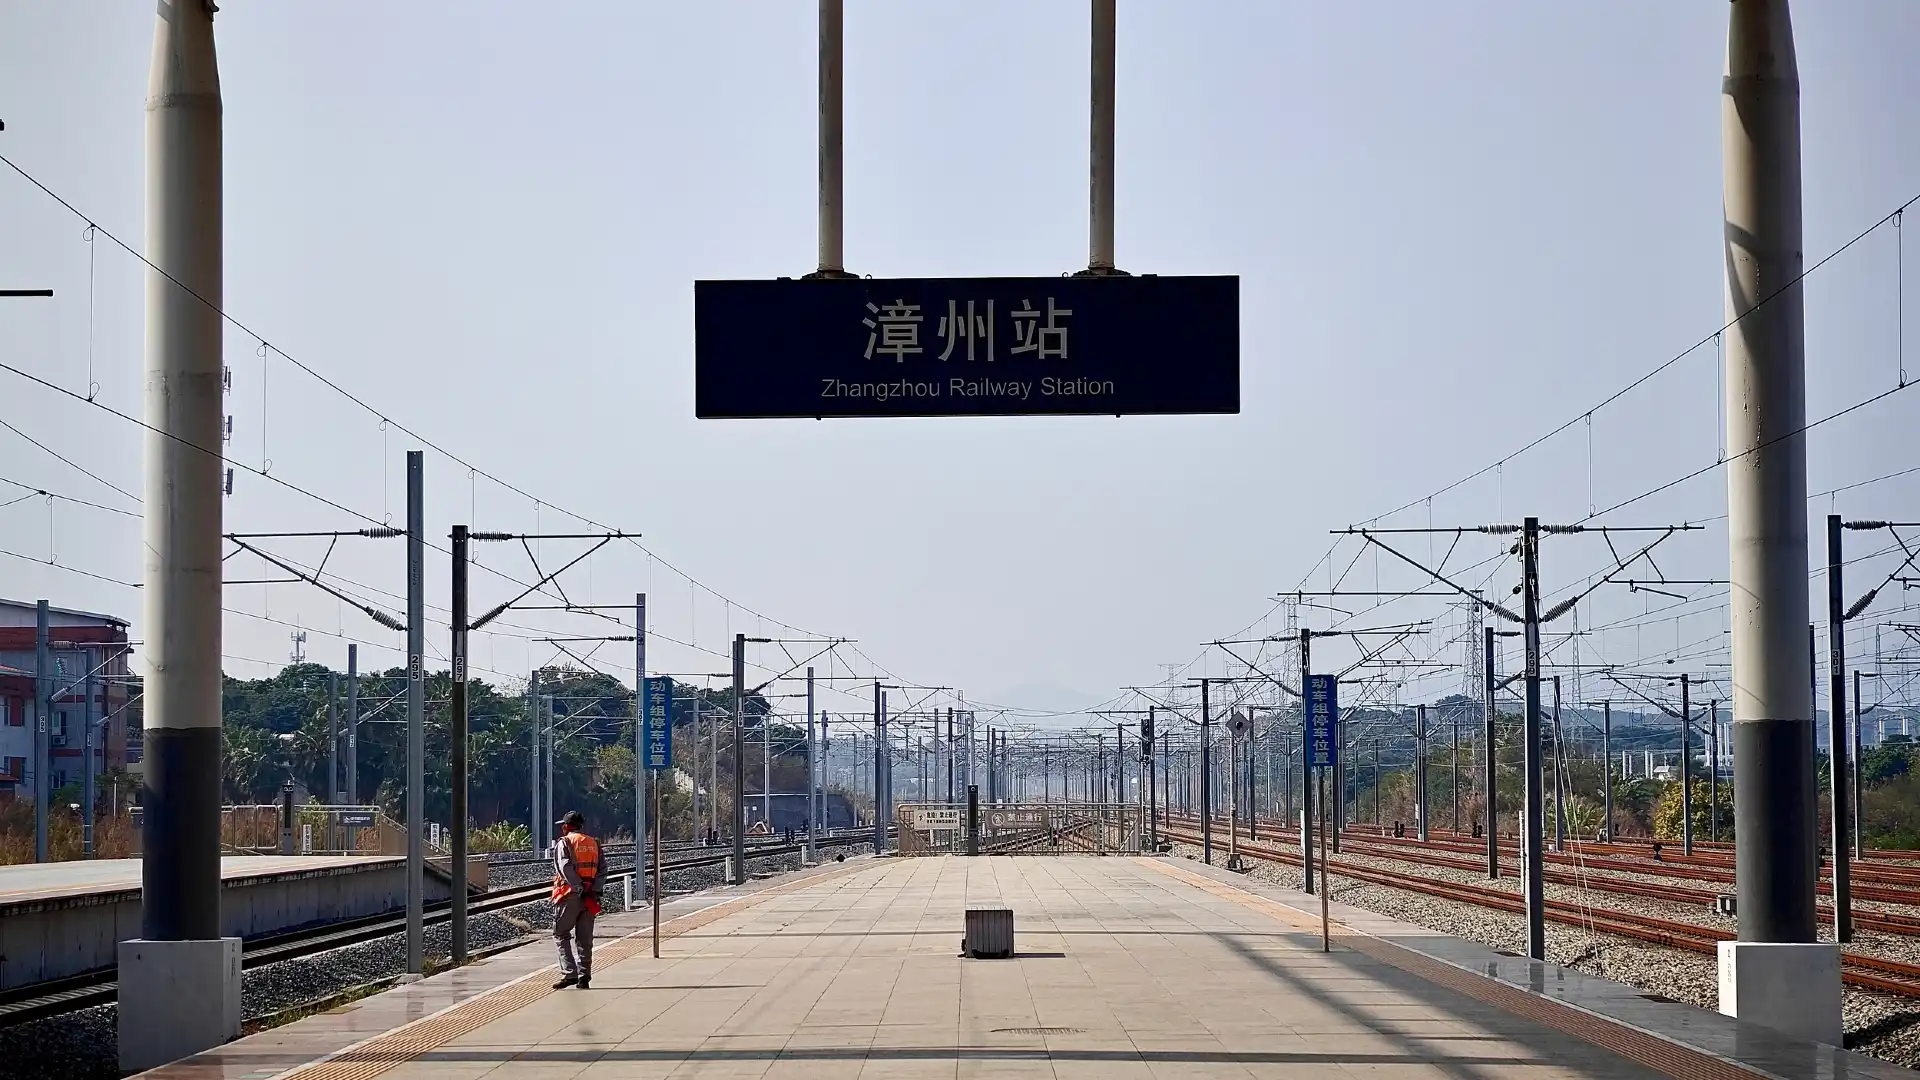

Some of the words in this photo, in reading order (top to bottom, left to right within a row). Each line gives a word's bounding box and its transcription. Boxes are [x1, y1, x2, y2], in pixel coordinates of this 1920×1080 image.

[862, 297, 1073, 363] 漳州站
[821, 378, 941, 401] Zhangzhou
[949, 377, 1033, 400] Railway
[1040, 376, 1115, 396] Station
[411, 655, 419, 680] 295
[1528, 651, 1536, 675] 299
[1832, 650, 1840, 675] 301
[649, 680, 667, 766] 动车组停车位置
[1311, 677, 1330, 764] 动车组停车位置
[1007, 812, 1043, 822] 禁止通行
